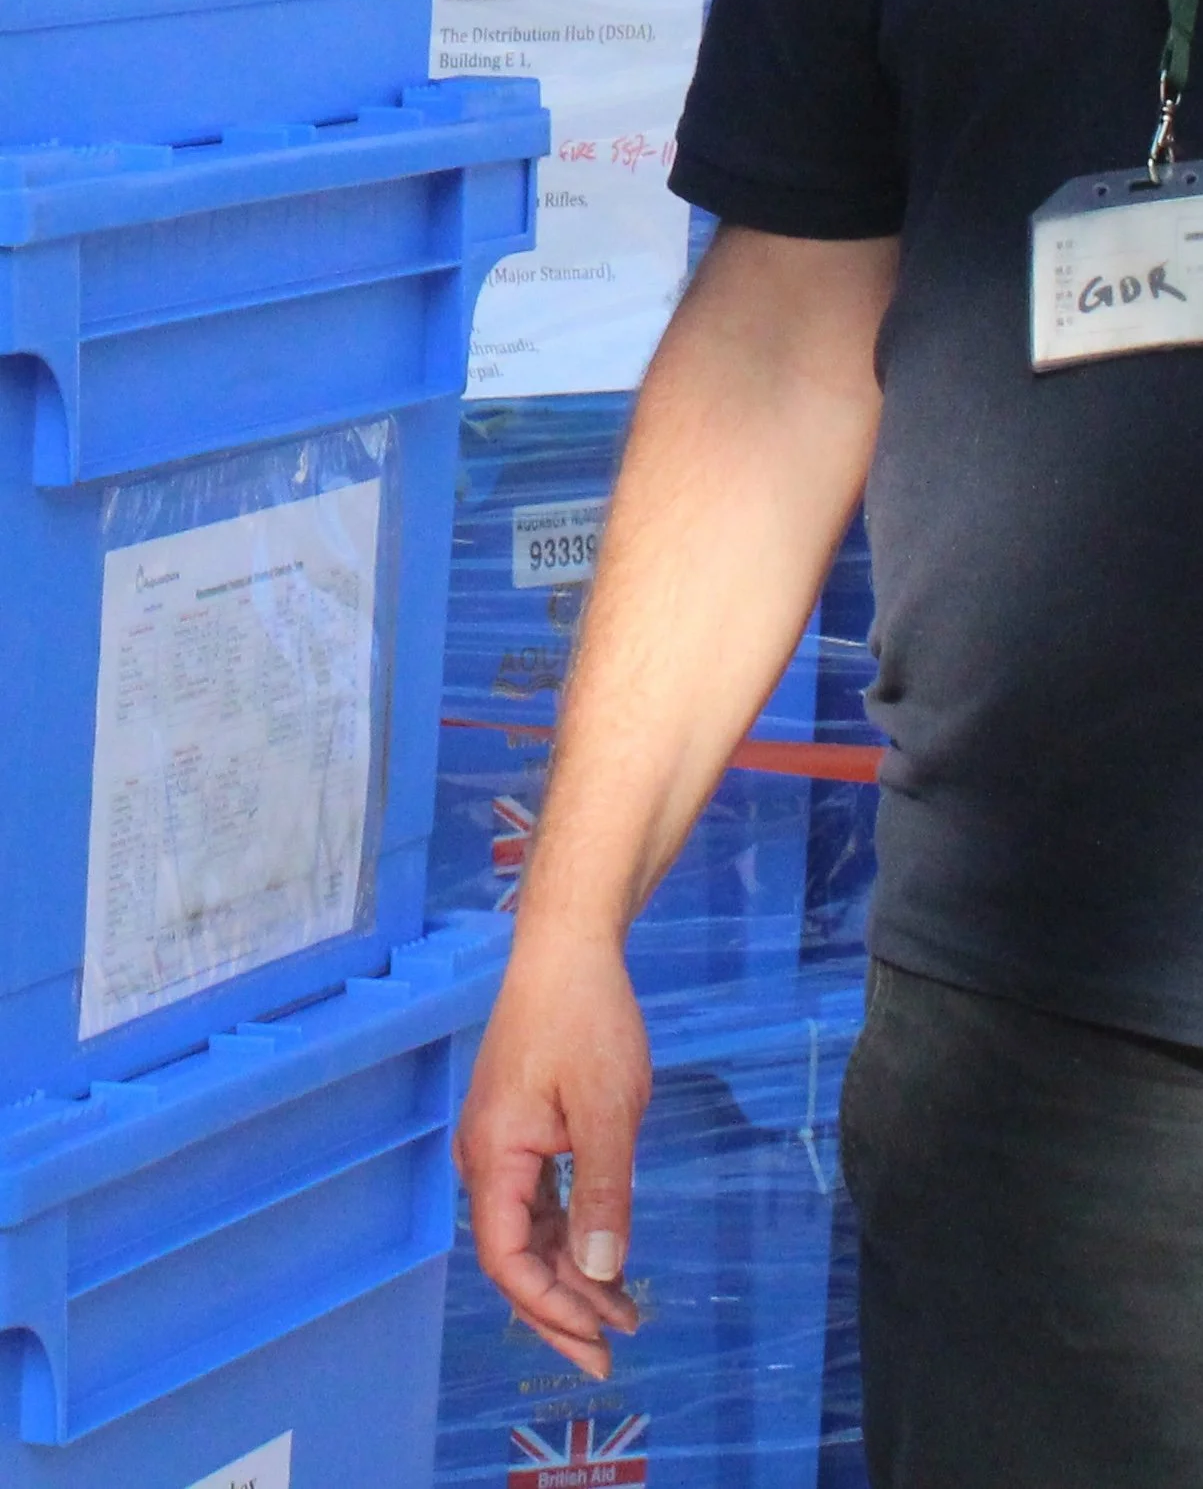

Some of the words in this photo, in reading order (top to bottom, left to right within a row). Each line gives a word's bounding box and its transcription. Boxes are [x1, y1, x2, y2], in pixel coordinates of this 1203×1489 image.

[440, 27, 468, 43] The
[472, 26, 560, 43] Distribution
[564, 25, 595, 41] Hub
[439, 51, 501, 71] Building
[505, 52, 514, 67] E
[488, 267, 536, 287] (Major
[470, 337, 541, 356] hmandu,
[469, 363, 505, 383] epal.
[537, 1467, 588, 1489] British
[591, 1464, 616, 1482] Aid
